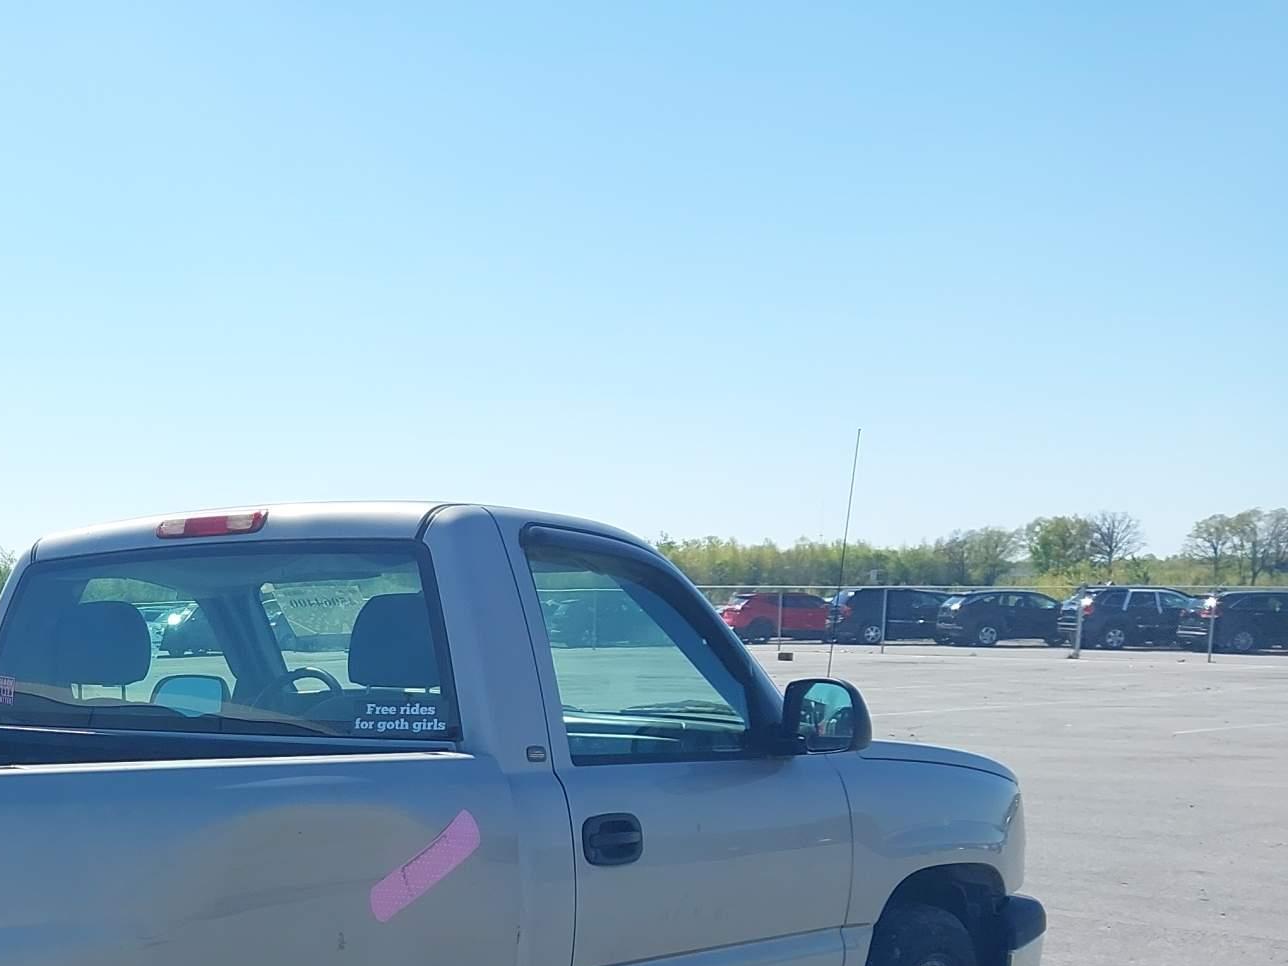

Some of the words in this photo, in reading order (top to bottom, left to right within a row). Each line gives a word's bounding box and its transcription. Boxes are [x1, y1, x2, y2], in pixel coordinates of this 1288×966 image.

[366, 704, 397, 715] Free
[399, 703, 436, 715] rides
[354, 718, 375, 729] for
[377, 719, 409, 732] goth
[412, 719, 446, 732] girls
